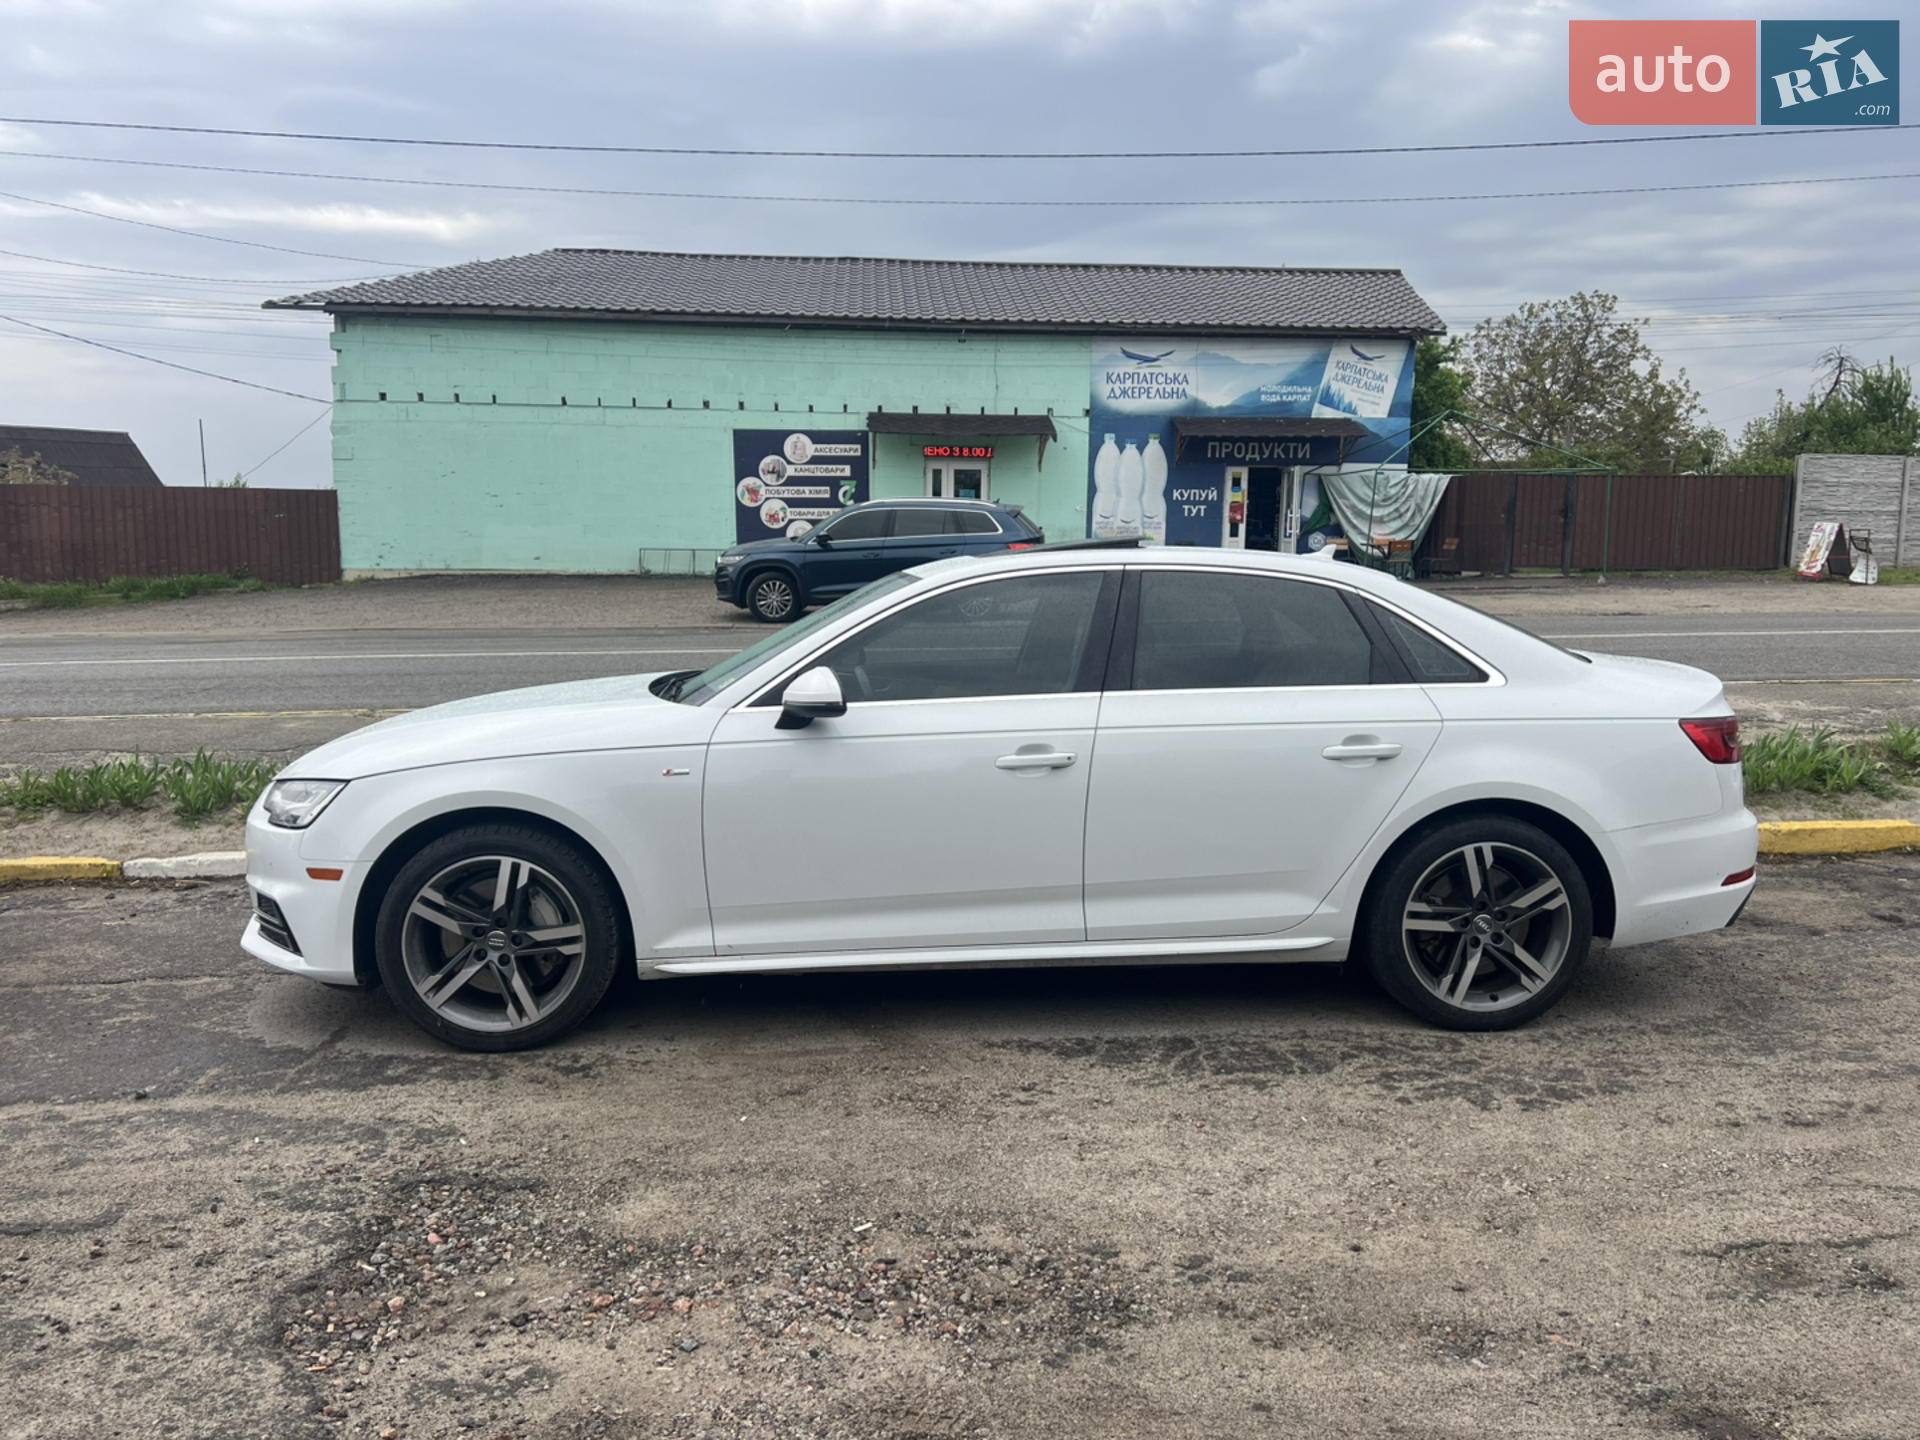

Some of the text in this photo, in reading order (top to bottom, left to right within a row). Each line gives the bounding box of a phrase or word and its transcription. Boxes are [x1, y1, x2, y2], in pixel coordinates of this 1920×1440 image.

[1106, 371, 1189, 385] КАРПАТСЬКА
[1334, 359, 1389, 384] КАРПАТСЬКА
[1332, 372, 1385, 394] ДЖЕРЕЛЬНА
[1106, 386, 1188, 400] ДЖЕРЕЛЬНА
[1260, 394, 1311, 402] ВОДА КАРПАТ
[813, 446, 860, 454] АКСЕСУАРИ
[1207, 441, 1311, 461] ПРОДУКТИ
[794, 466, 846, 475] КАНЦТОВАРИ
[765, 488, 829, 496] ПОБУТОВА ХІМІЯ
[1172, 486, 1218, 501] КУПУЙ
[789, 510, 815, 521] ТОВАРИ
[1182, 504, 1207, 517] ТУТ
